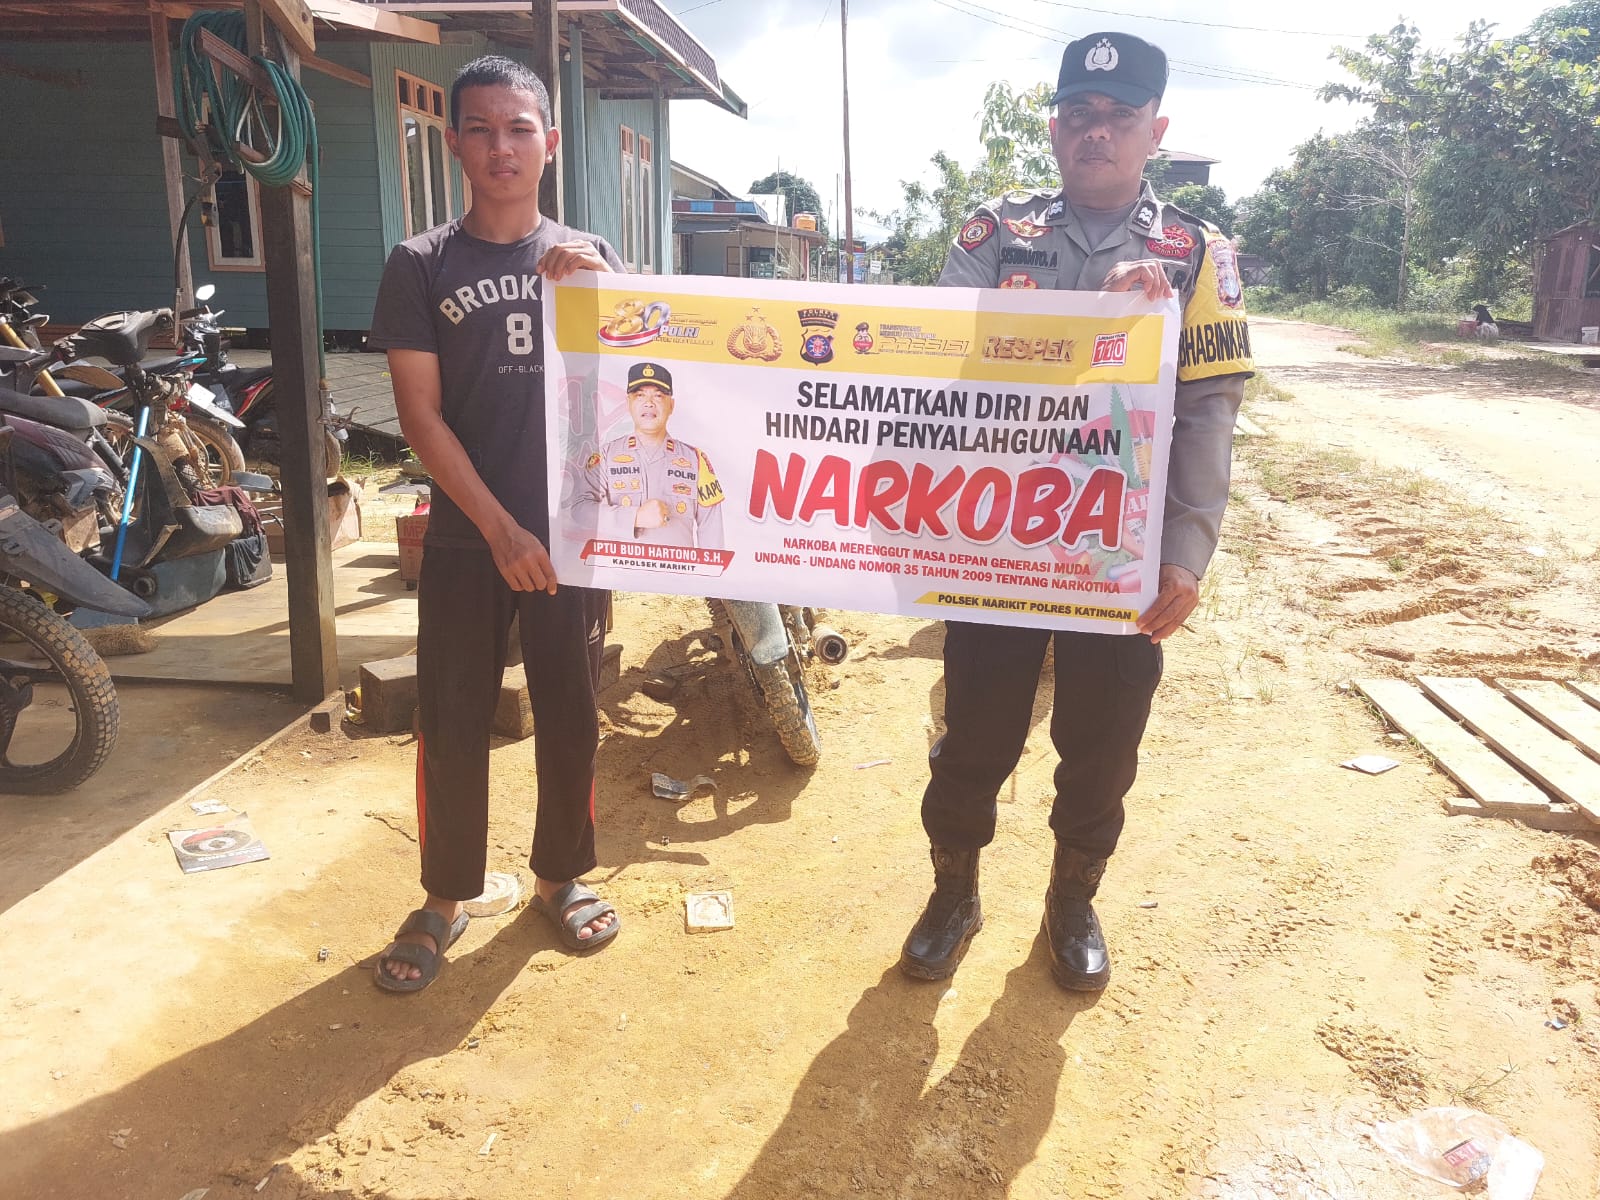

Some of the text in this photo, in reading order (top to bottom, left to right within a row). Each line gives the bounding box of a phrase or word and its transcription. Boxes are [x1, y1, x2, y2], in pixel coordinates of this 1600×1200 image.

[439, 274, 543, 326] BROOK
[506, 312, 533, 355] 8
[658, 326, 700, 338] POLRI
[1096, 340, 1124, 361] 110
[797, 381, 1089, 422] SELAMATKAN DIRI DAN
[765, 411, 1122, 456] HINDARI PENYALAHGUNAAN
[610, 466, 641, 476] BUDI.H
[667, 469, 697, 481] POLRI
[748, 447, 1126, 549] NARKOBA
[593, 541, 724, 564] IPTU BUDI HARTONO, S.H.
[612, 558, 697, 572] KAPOLSEK MARIKIT
[783, 537, 1091, 576] NARKOBA MERENGGUT MASA DEPAN GENERASI MUDA
[754, 552, 801, 566] UNDANG
[809, 556, 856, 570] UNDANG
[858, 560, 901, 574] NOMOR
[903, 564, 919, 575] 35
[922, 565, 960, 580] TAHUN
[962, 570, 993, 582] 2009
[995, 573, 1049, 588] TENTANG
[1051, 579, 1121, 595] NARKOTIKA
[938, 594, 1132, 620] POLSEK MARIKIT POLRES KATINGAN
